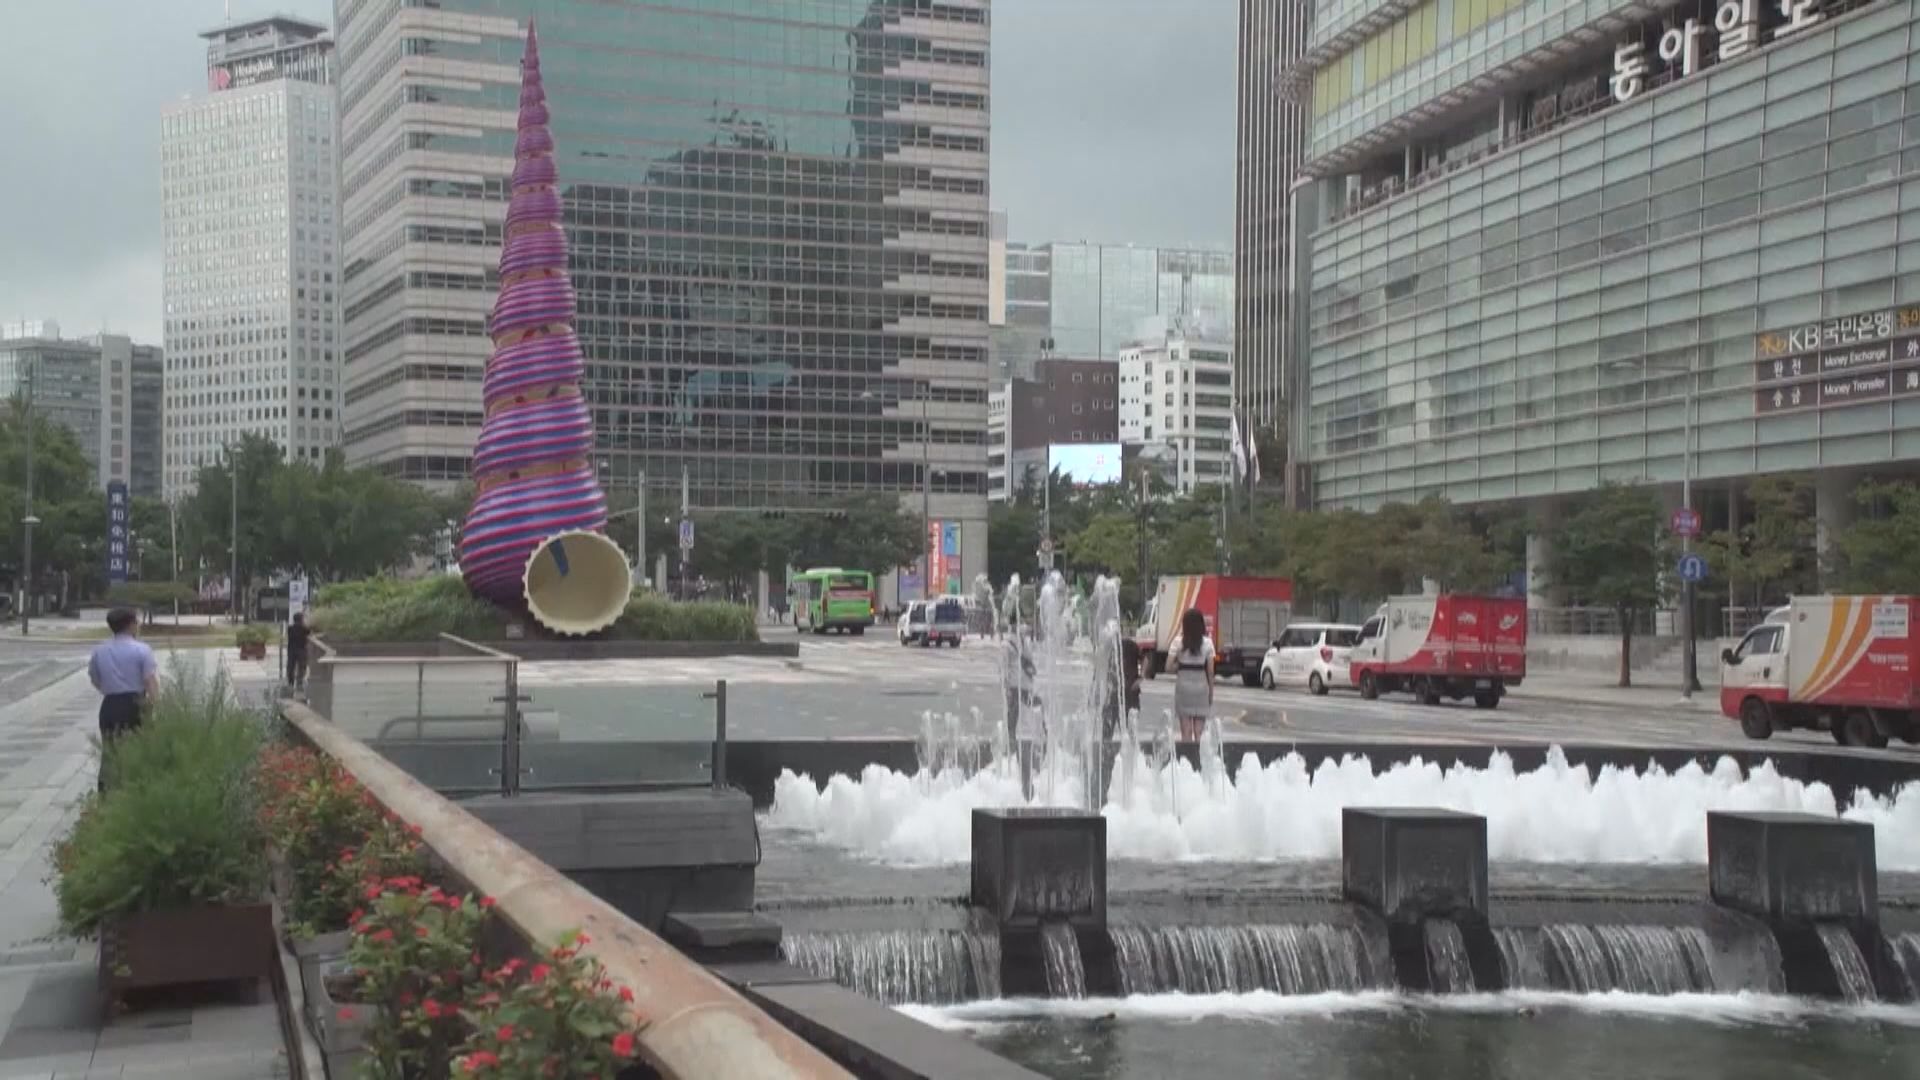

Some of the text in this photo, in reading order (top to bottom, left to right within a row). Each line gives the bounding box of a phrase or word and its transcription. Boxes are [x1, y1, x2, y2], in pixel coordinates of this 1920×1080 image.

[1824, 354, 1849, 367] Money
[1850, 349, 1887, 364] Exchange
[1824, 383, 1850, 395] Money
[1852, 377, 1886, 392] Transfer
